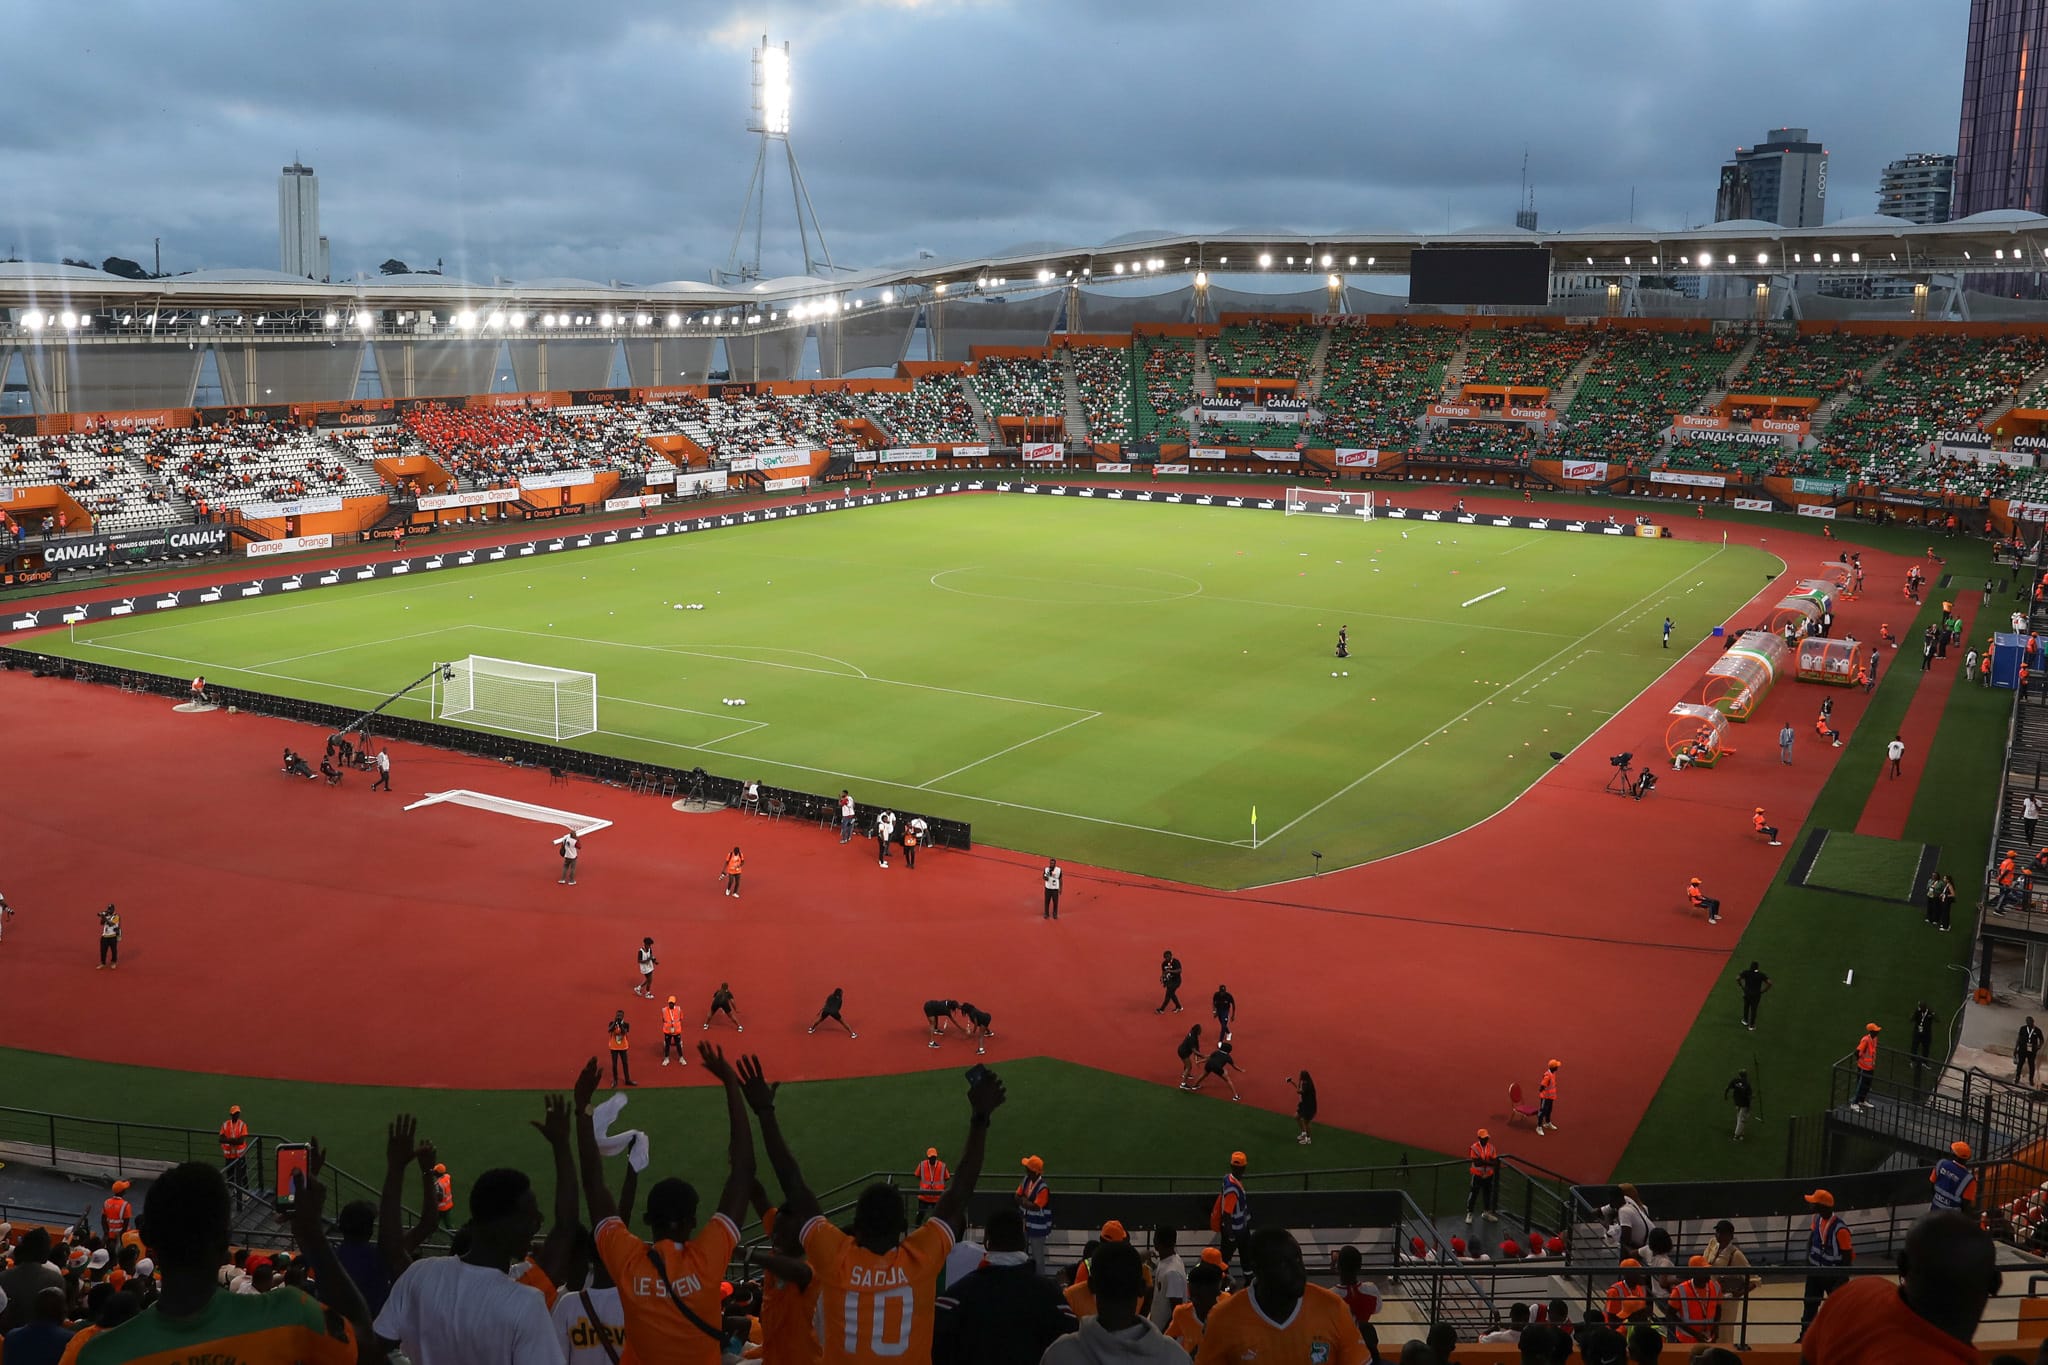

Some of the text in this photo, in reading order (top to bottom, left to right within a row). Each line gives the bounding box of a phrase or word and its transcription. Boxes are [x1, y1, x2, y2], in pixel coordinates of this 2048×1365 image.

[1202, 397, 1241, 408] CANAL+
[1267, 399, 1309, 409] CANAL+
[1434, 404, 1470, 416] Orange
[1511, 408, 1547, 419] Orange
[121, 417, 133, 427] de
[134, 416, 159, 428] jouer
[342, 413, 379, 425] Orange
[1683, 415, 1719, 428] Orange
[1763, 419, 1801, 432] Orange
[1690, 431, 1780, 445] CANAL+ CANAL+
[1944, 431, 1991, 443] CANAL+
[2014, 436, 2048, 448] CANA
[18, 490, 25, 498] 11
[419, 490, 513, 508] Orange Orange Orange
[607, 499, 630, 509] Orange
[150, 538, 166, 546] NOUS
[170, 529, 226, 547] CANAL+
[298, 536, 329, 548] Orange
[44, 542, 107, 562] CANAL+
[250, 541, 283, 553] Orange
[19, 570, 52, 583] Orange
[633, 1276, 651, 1296] LE
[844, 1285, 914, 1357] 10
